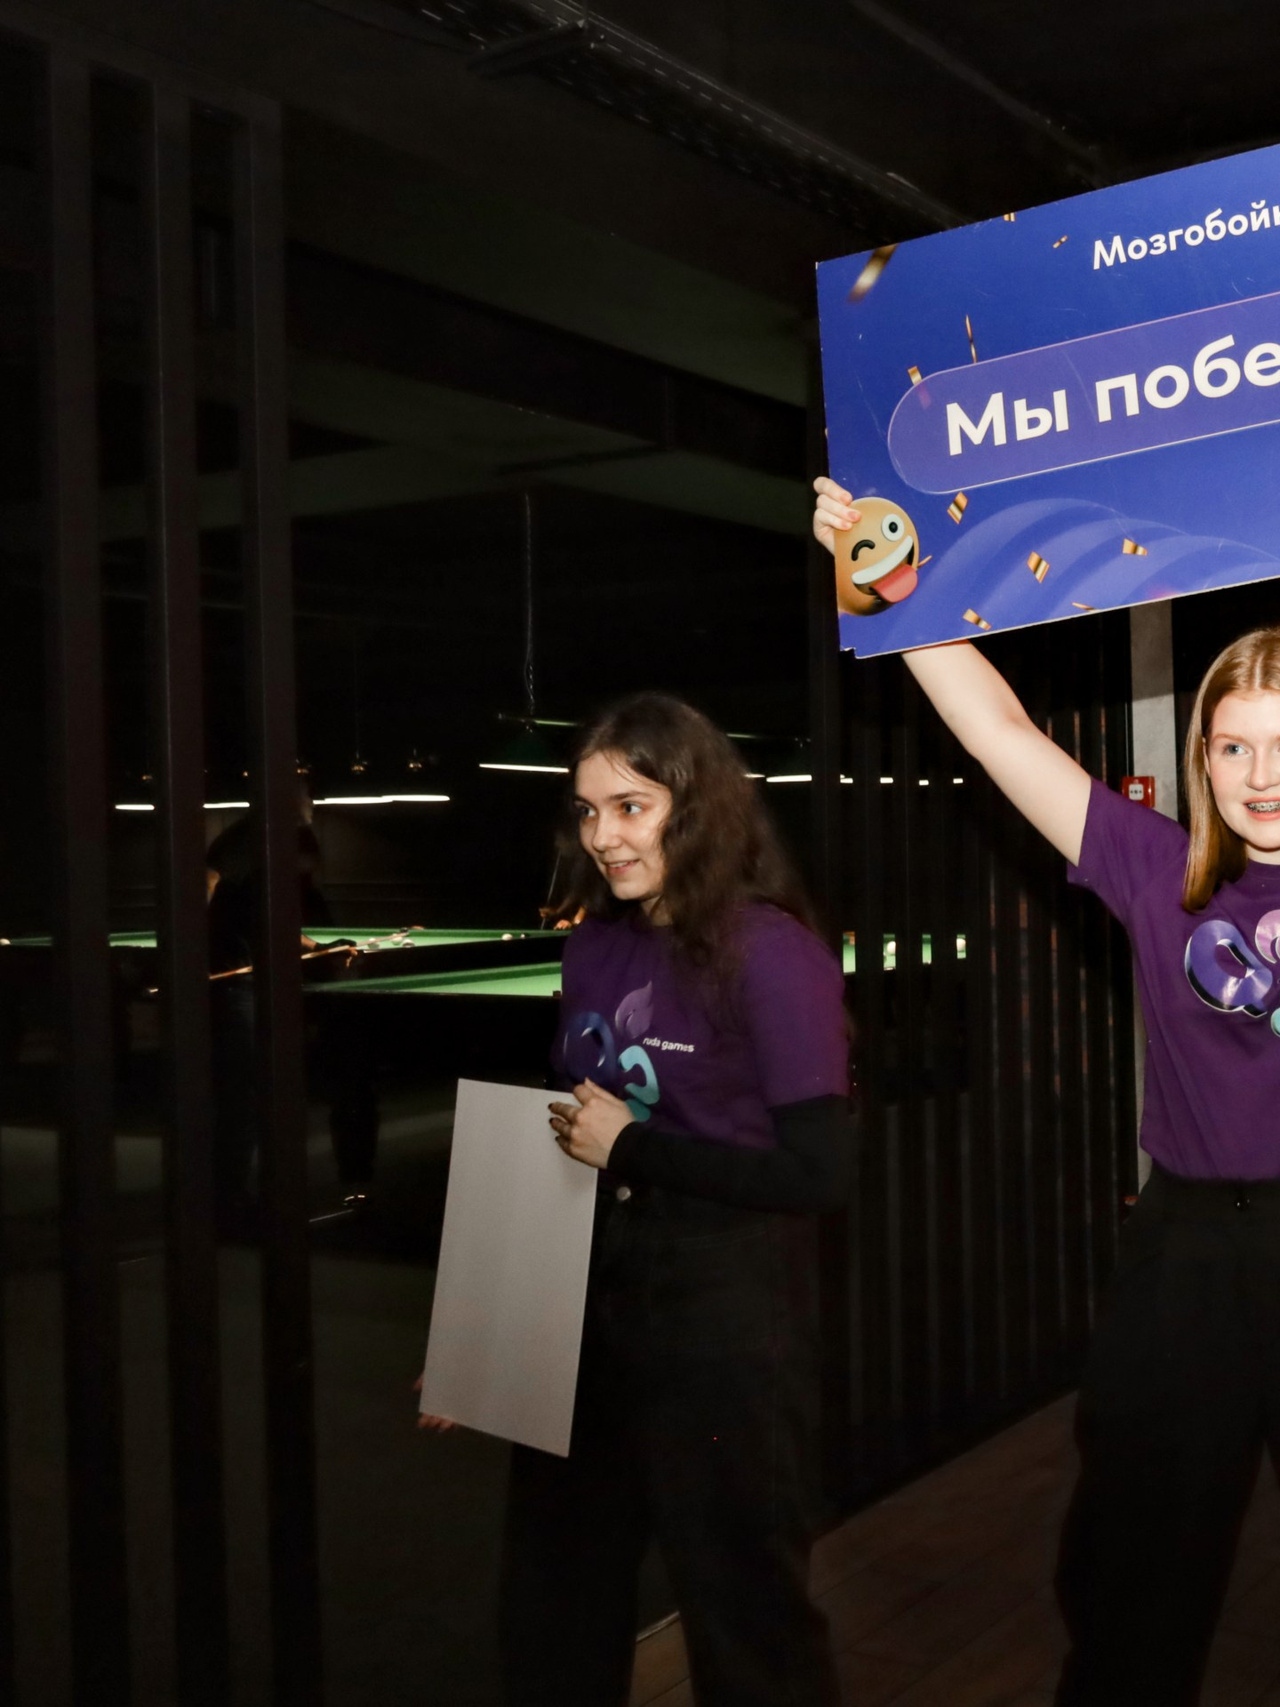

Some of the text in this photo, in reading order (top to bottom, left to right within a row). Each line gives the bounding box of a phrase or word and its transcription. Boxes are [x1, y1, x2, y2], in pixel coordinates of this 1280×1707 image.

[946, 389, 1069, 457] Мы
[642, 1037, 695, 1053] ruda games
